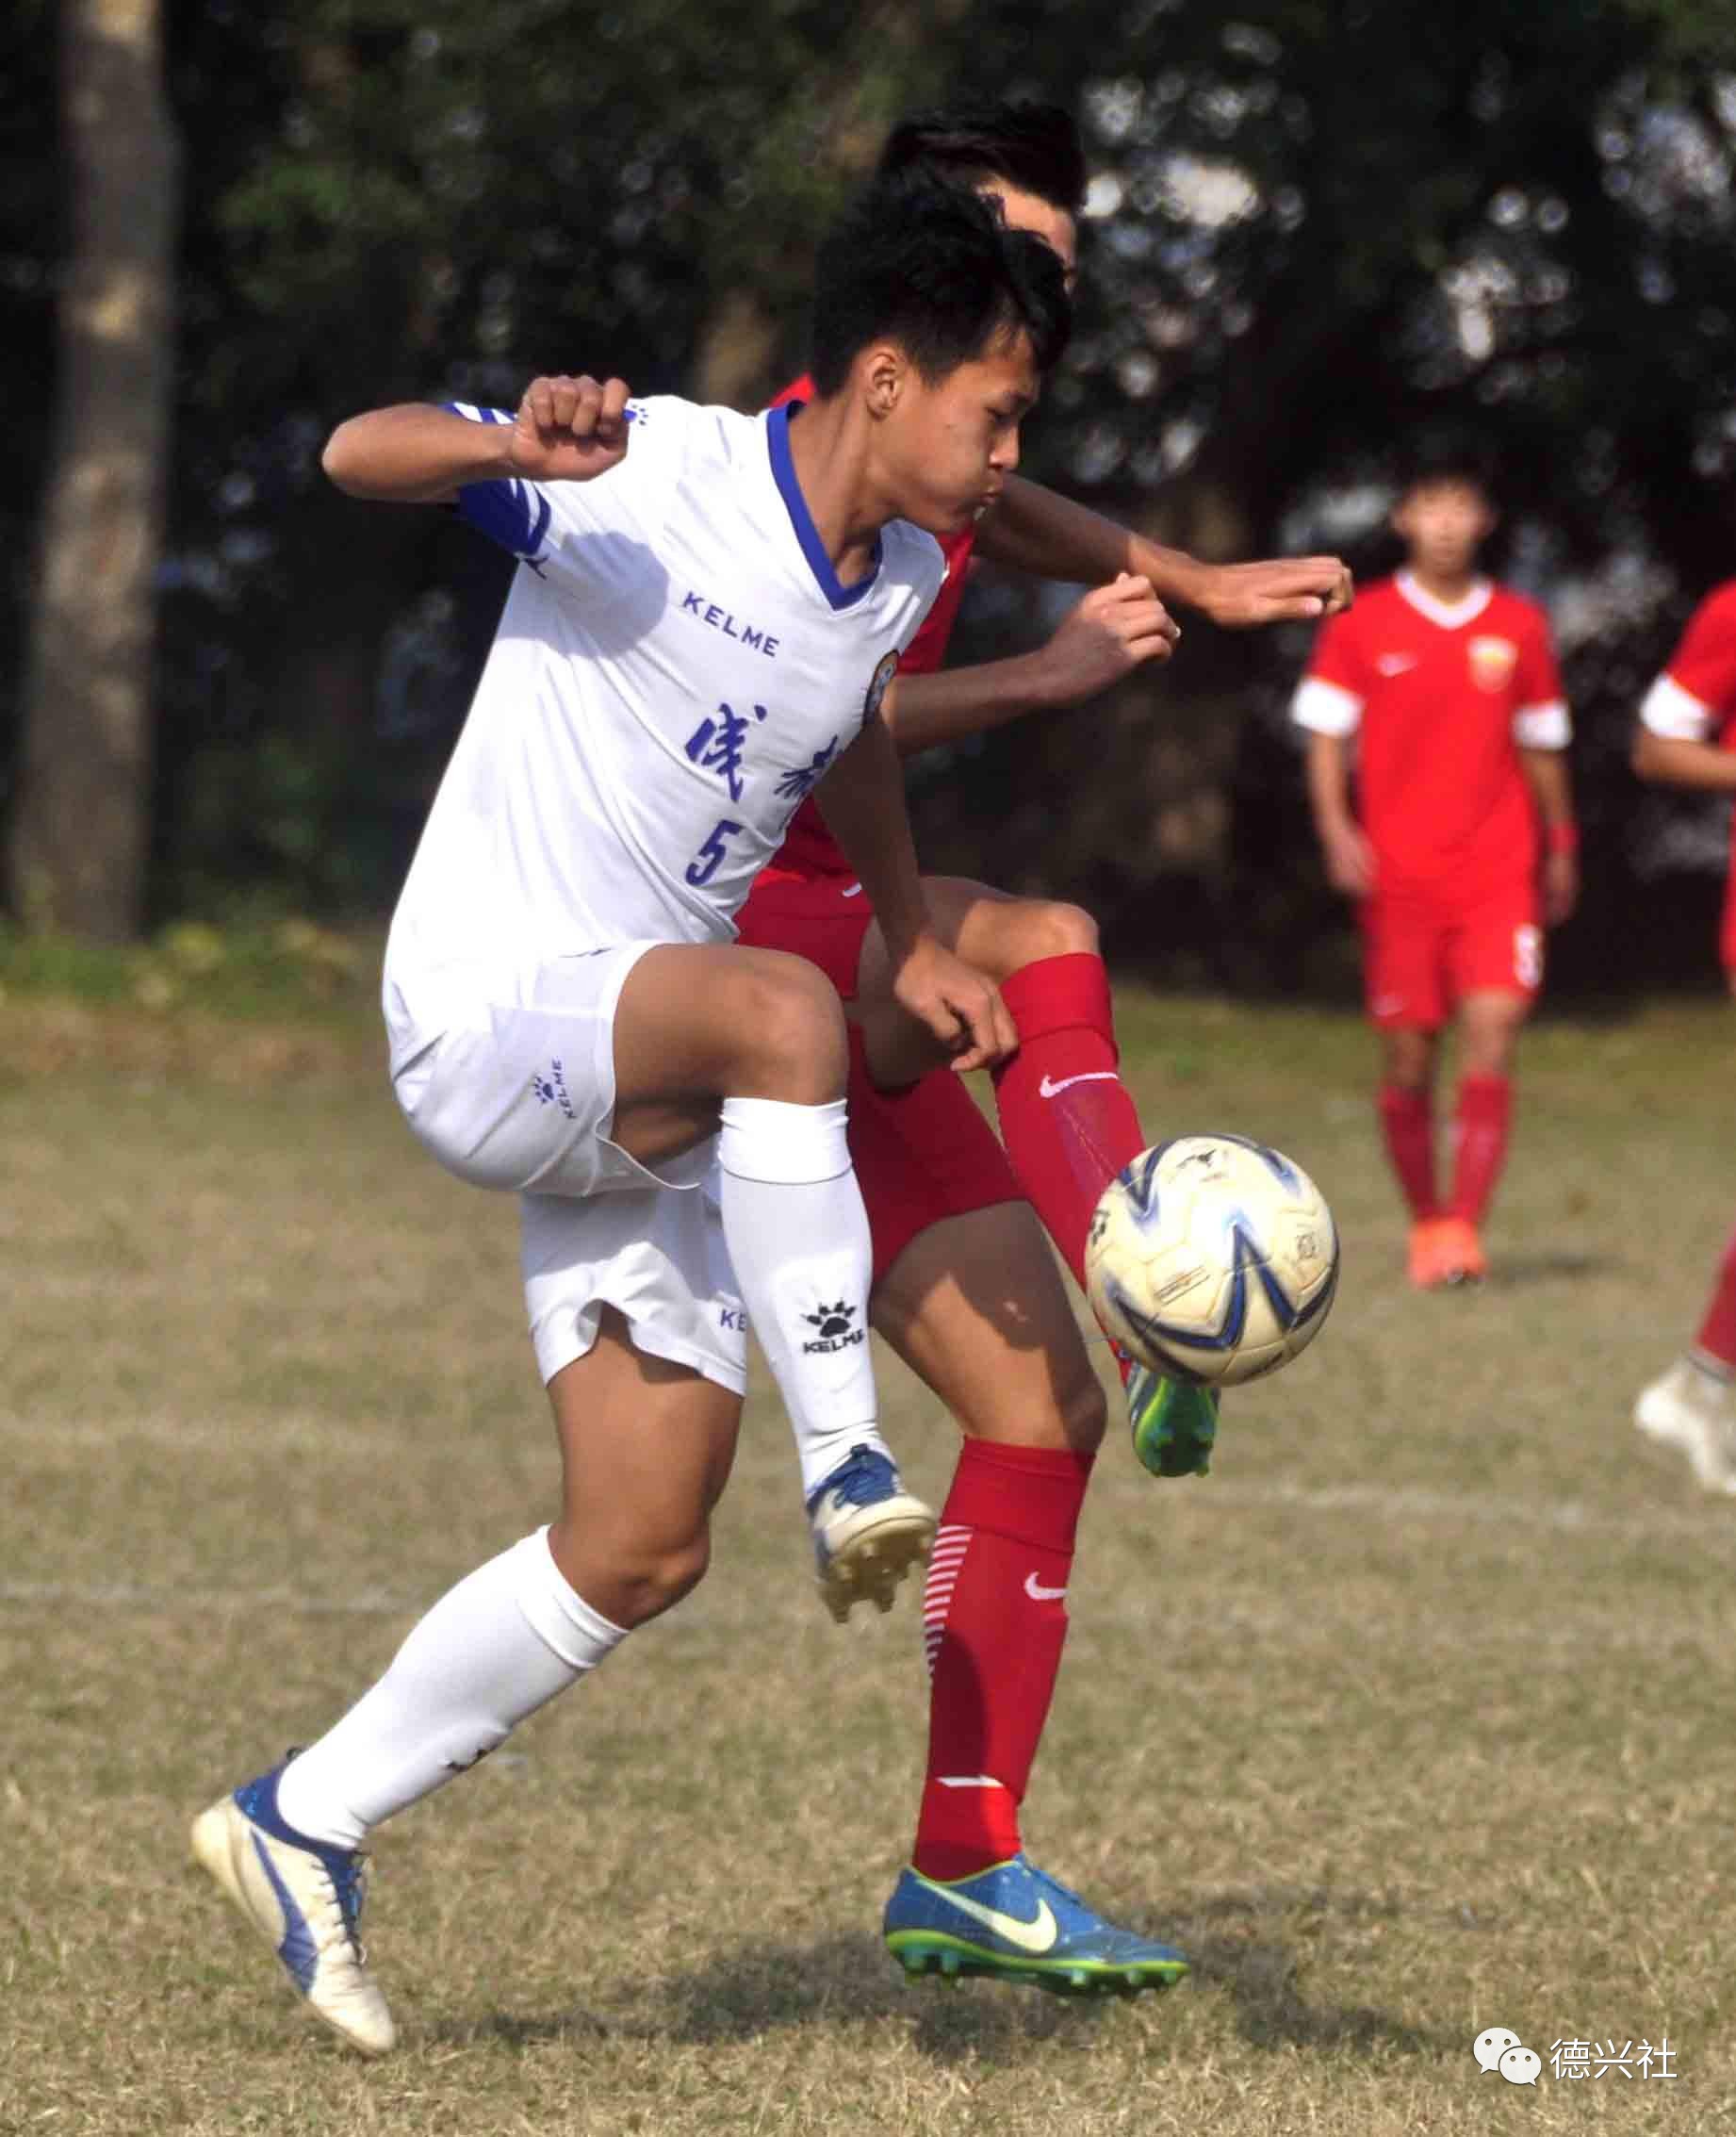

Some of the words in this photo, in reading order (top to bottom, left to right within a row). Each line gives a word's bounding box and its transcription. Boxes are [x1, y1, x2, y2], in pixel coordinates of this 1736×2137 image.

[683, 591, 779, 657] KELME
[685, 819, 743, 886] 5
[551, 1058, 577, 1119] KELME
